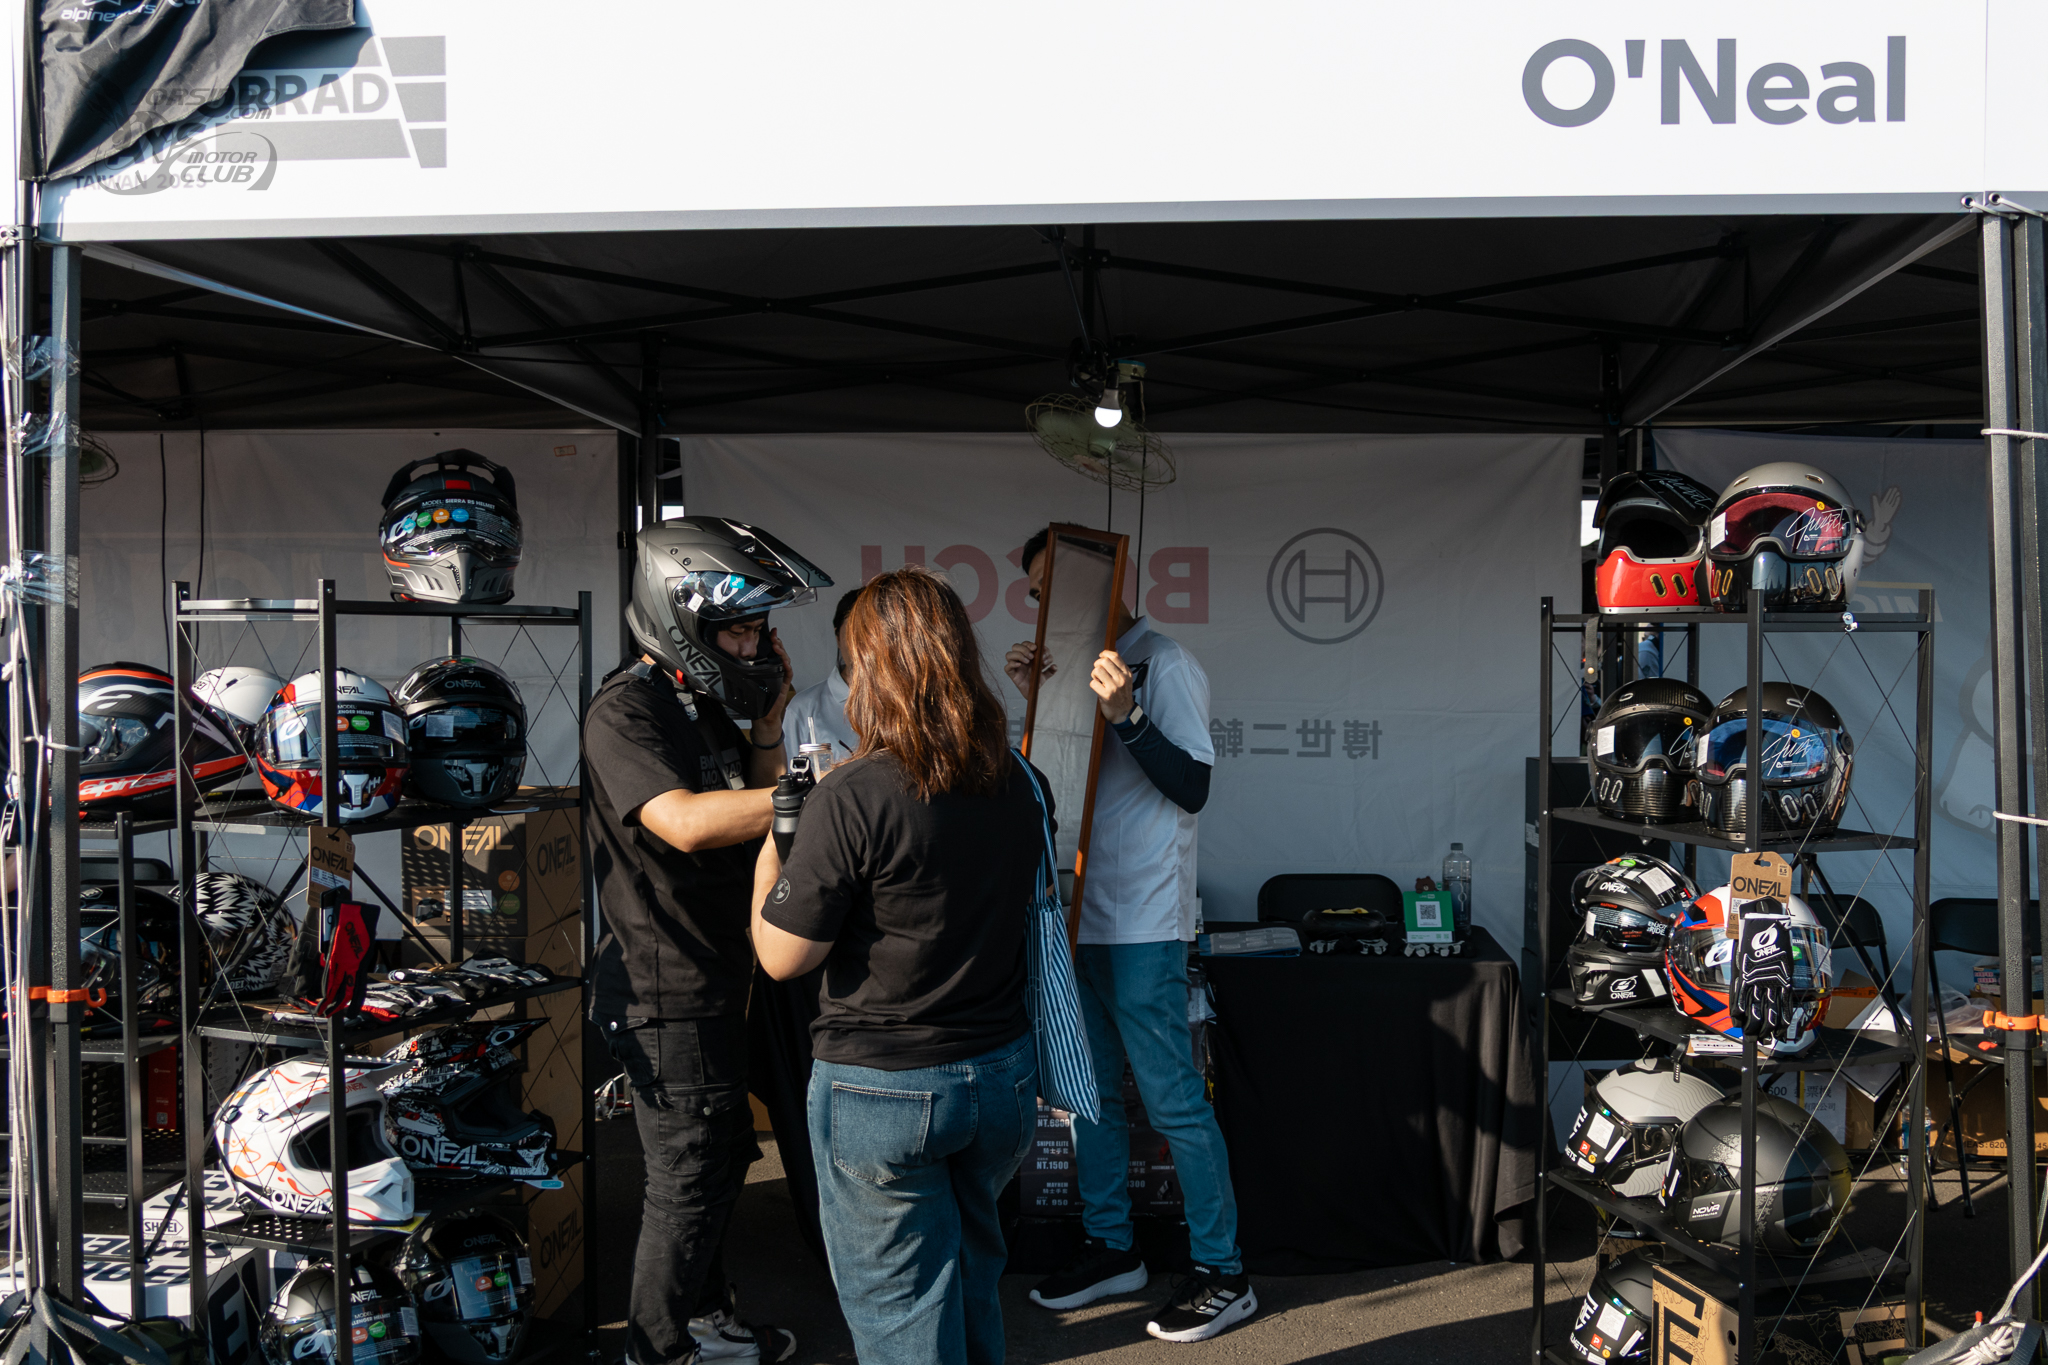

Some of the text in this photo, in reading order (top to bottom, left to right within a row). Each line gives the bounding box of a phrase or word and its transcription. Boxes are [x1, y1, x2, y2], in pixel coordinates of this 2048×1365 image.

[1522, 36, 1906, 127] O'Neal
[74, 173, 207, 190] TAIWAN 2025
[476, 500, 496, 510] HELMET
[1036, 1161, 1069, 1170] NT.1500
[1692, 1203, 1721, 1215] NOVA
[1195, 1265, 1210, 1274] adidas
